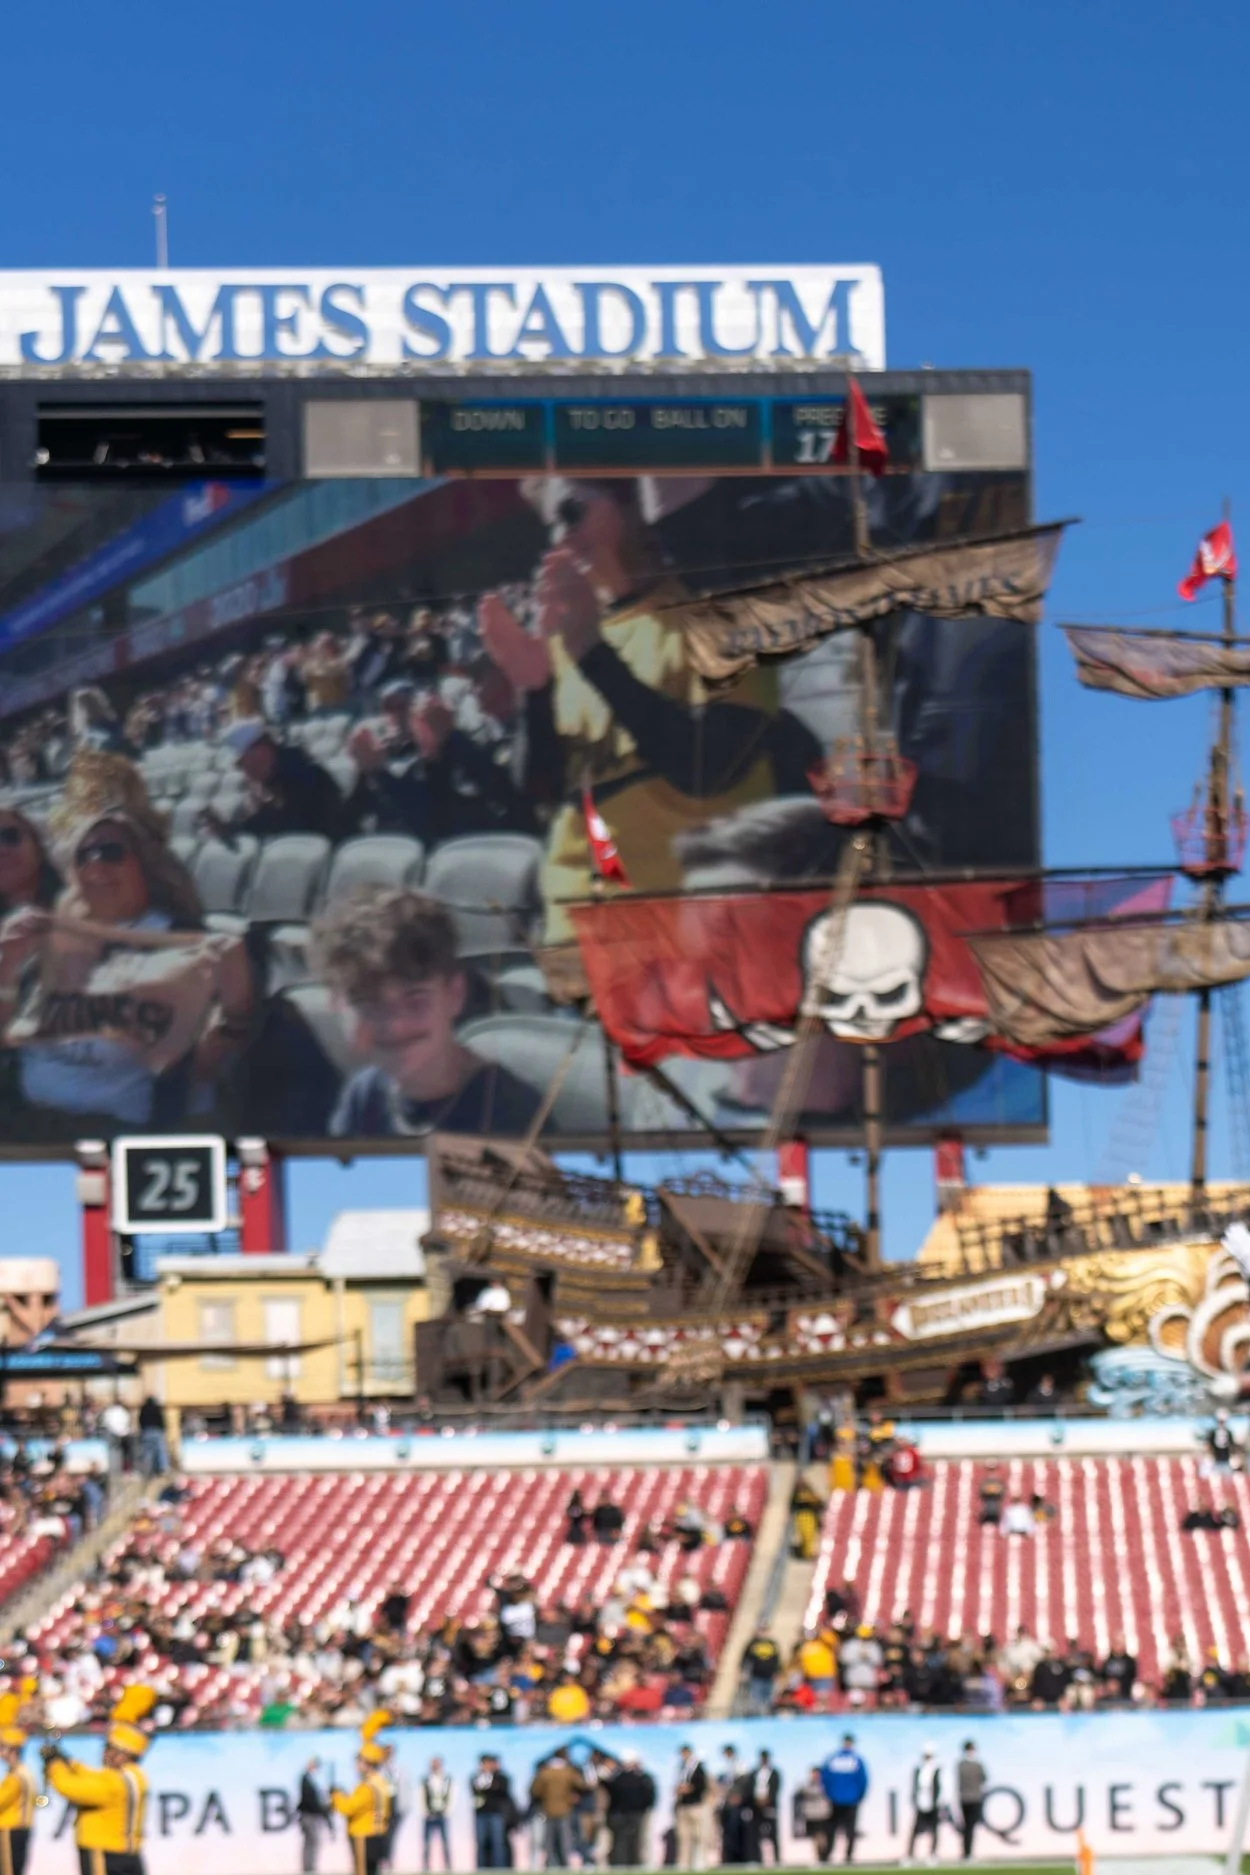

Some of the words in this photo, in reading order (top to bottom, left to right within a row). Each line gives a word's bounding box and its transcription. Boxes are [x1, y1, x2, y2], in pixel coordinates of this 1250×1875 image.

[19, 283, 371, 364] JAMES
[402, 279, 864, 360] STADIUM
[450, 409, 526, 431] DOWN
[568, 409, 600, 430] TO
[601, 409, 635, 429] GO
[651, 408, 709, 430] BALL
[712, 408, 747, 428] ON
[138, 1160, 201, 1212] 25
